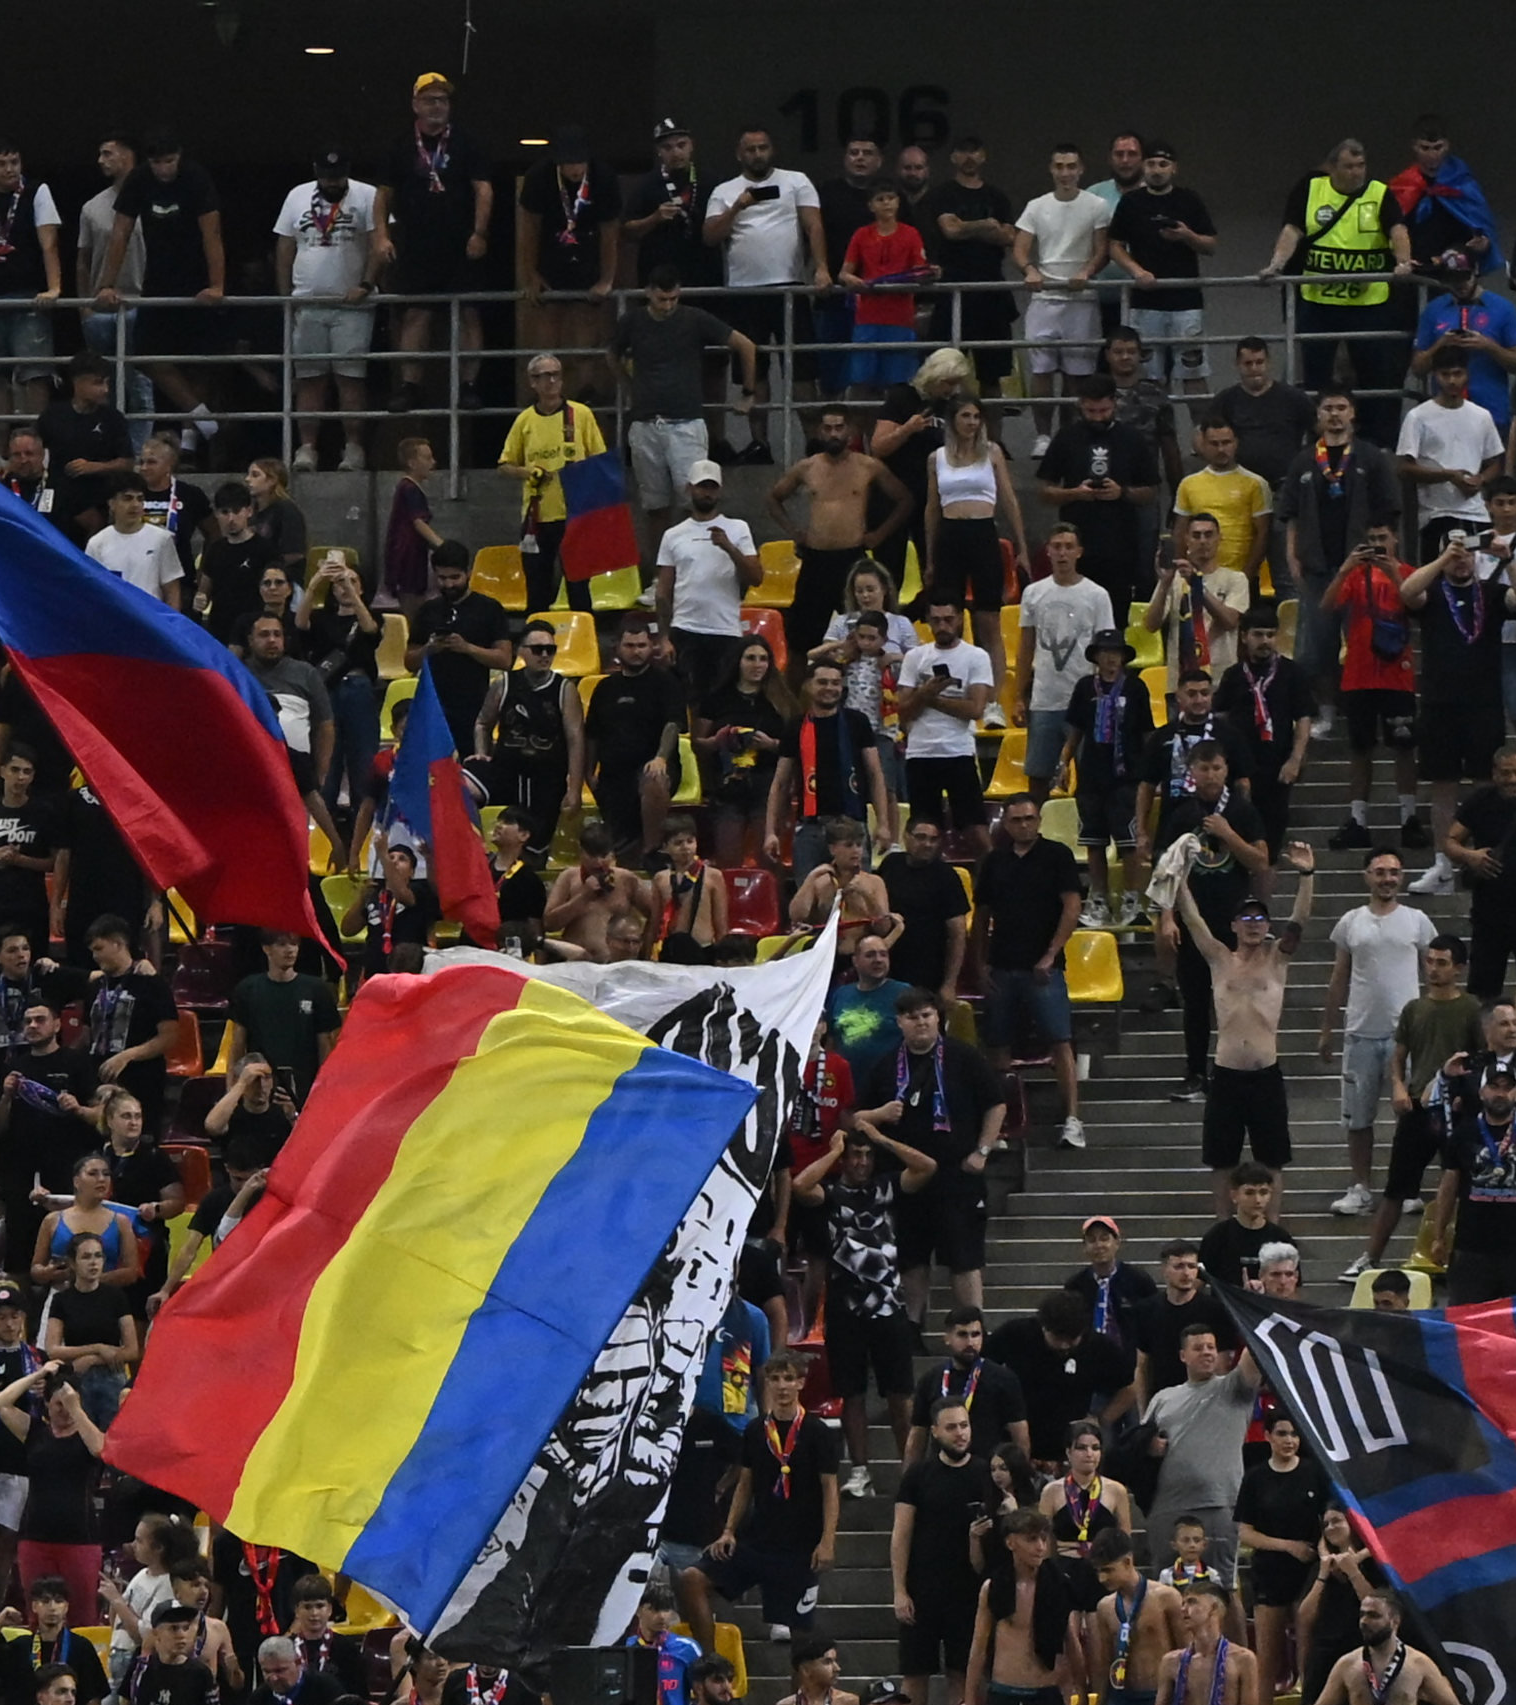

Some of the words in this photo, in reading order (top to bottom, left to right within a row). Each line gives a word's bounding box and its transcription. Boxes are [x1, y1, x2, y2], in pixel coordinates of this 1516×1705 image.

[777, 85, 950, 152] 106
[1305, 250, 1386, 272] STEWARD
[1320, 282, 1360, 298] 226
